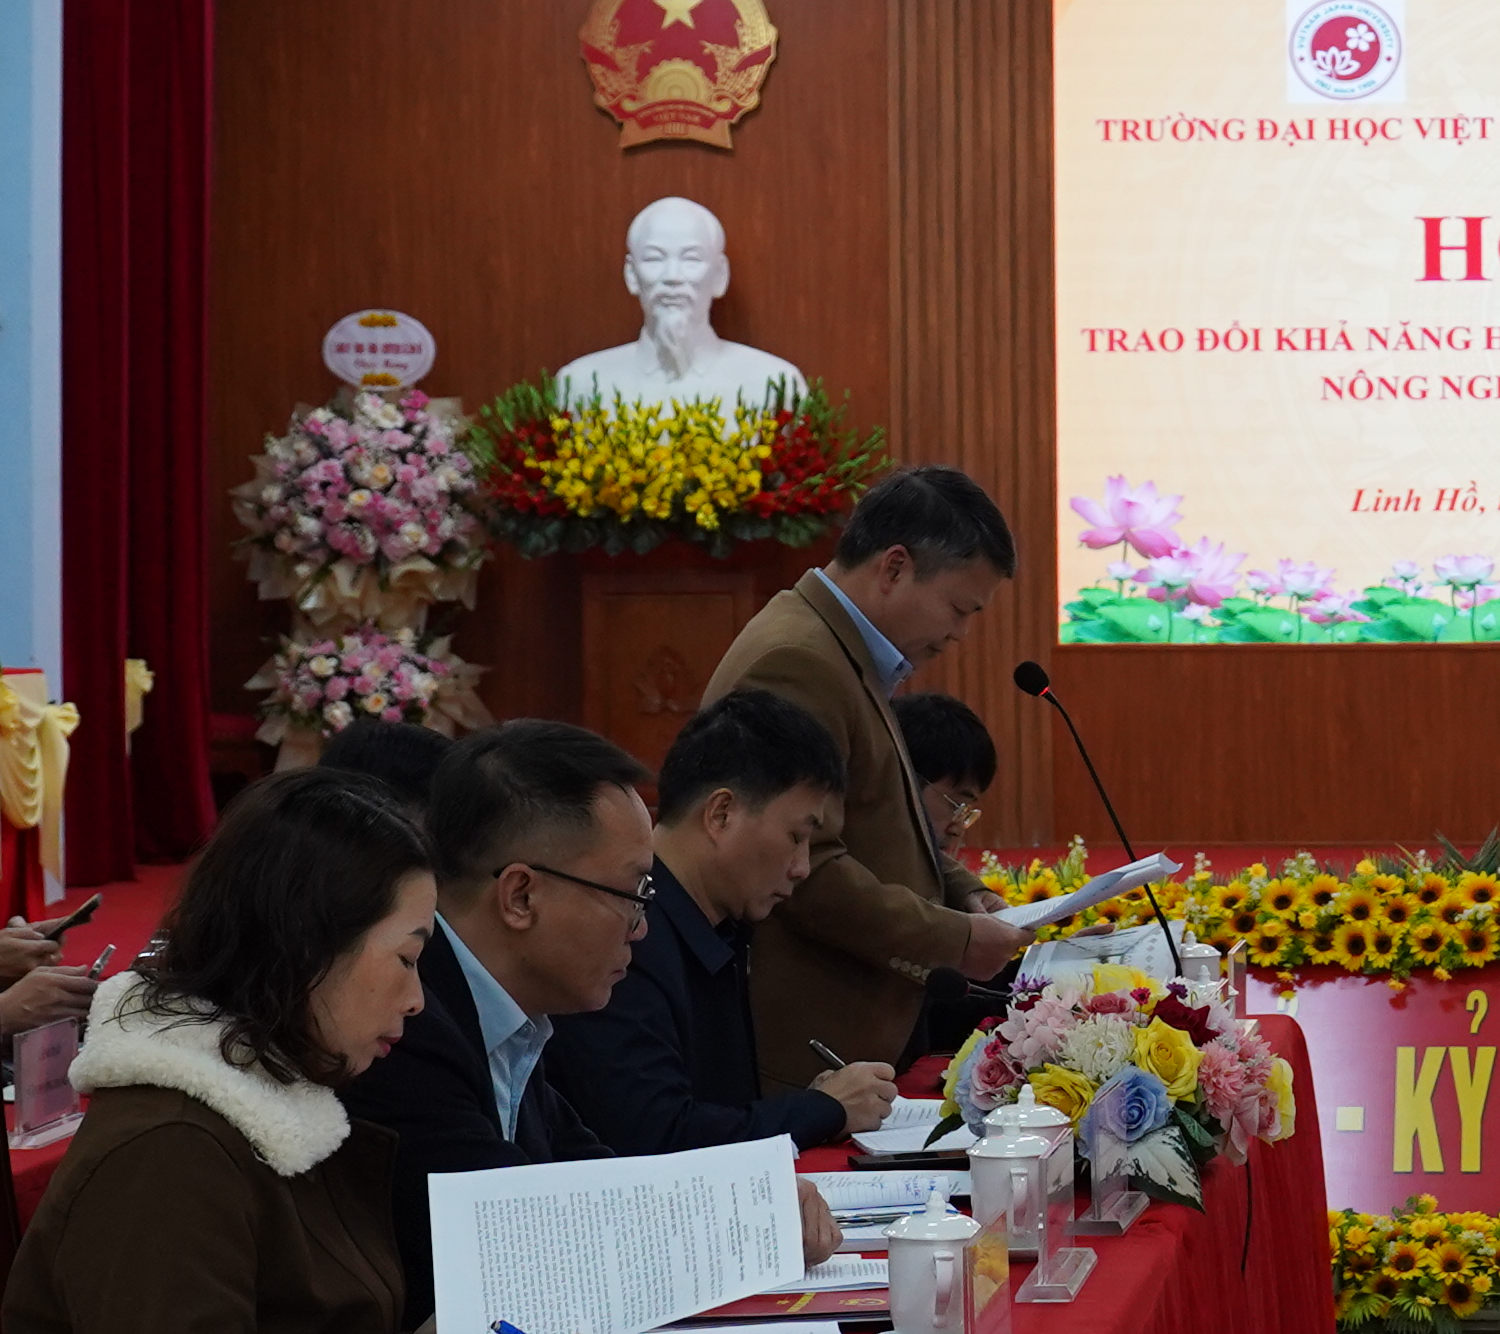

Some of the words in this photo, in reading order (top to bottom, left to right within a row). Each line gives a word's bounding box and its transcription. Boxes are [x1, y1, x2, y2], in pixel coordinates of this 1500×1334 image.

[1095, 112, 1246, 142] TRƯỜNG
[1257, 118, 1316, 147] ĐẠI
[1328, 118, 1402, 146] HỌC
[1413, 115, 1493, 145] VIỆT
[1080, 328, 1185, 353] TRAO
[1196, 321, 1262, 352] ĐỔI
[1275, 321, 1355, 352] KHẢ
[1367, 321, 1472, 351] NĂNG
[1322, 369, 1428, 400] NÔNG
[1350, 488, 1422, 512] Linh
[1433, 481, 1486, 513] Hồ,
[1393, 989, 1497, 1174] KỶ
